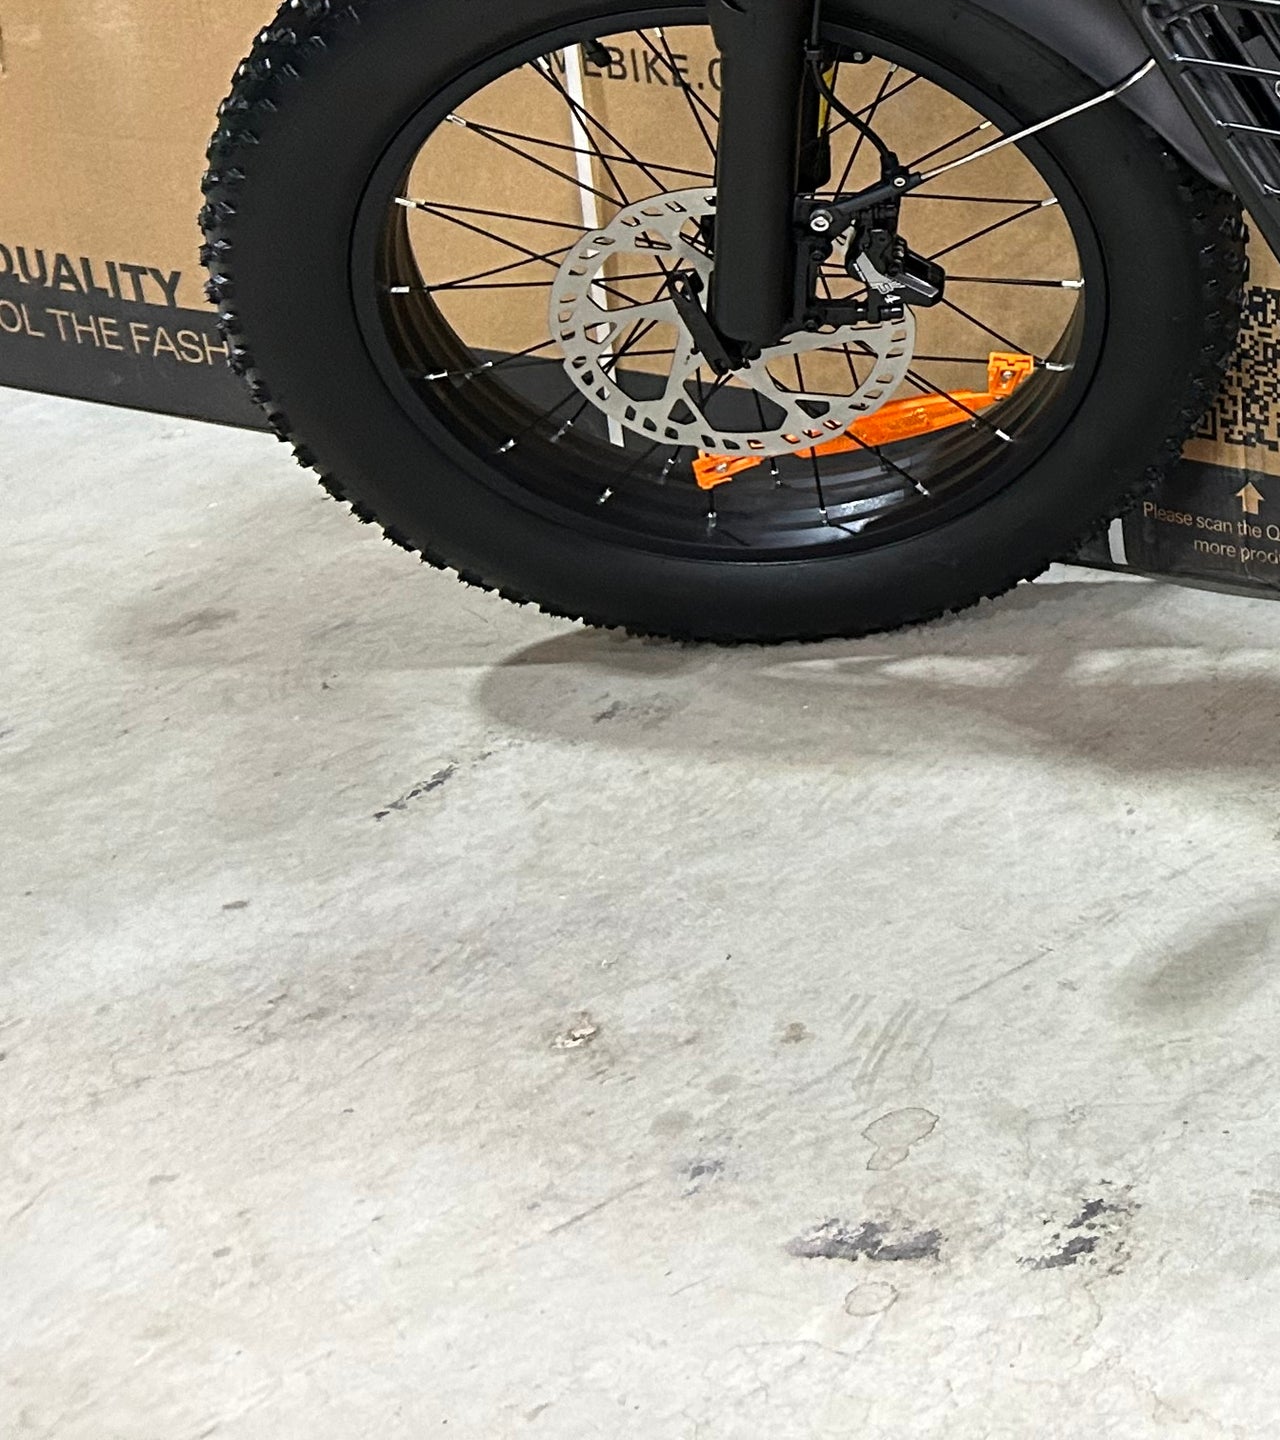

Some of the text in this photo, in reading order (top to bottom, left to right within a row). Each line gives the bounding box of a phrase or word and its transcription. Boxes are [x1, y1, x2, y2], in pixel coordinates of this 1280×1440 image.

[46, 307, 125, 352] THE
[1142, 501, 1193, 527] Please
[1195, 514, 1234, 535] scan
[1237, 519, 1263, 539] the
[1194, 538, 1237, 558] more
